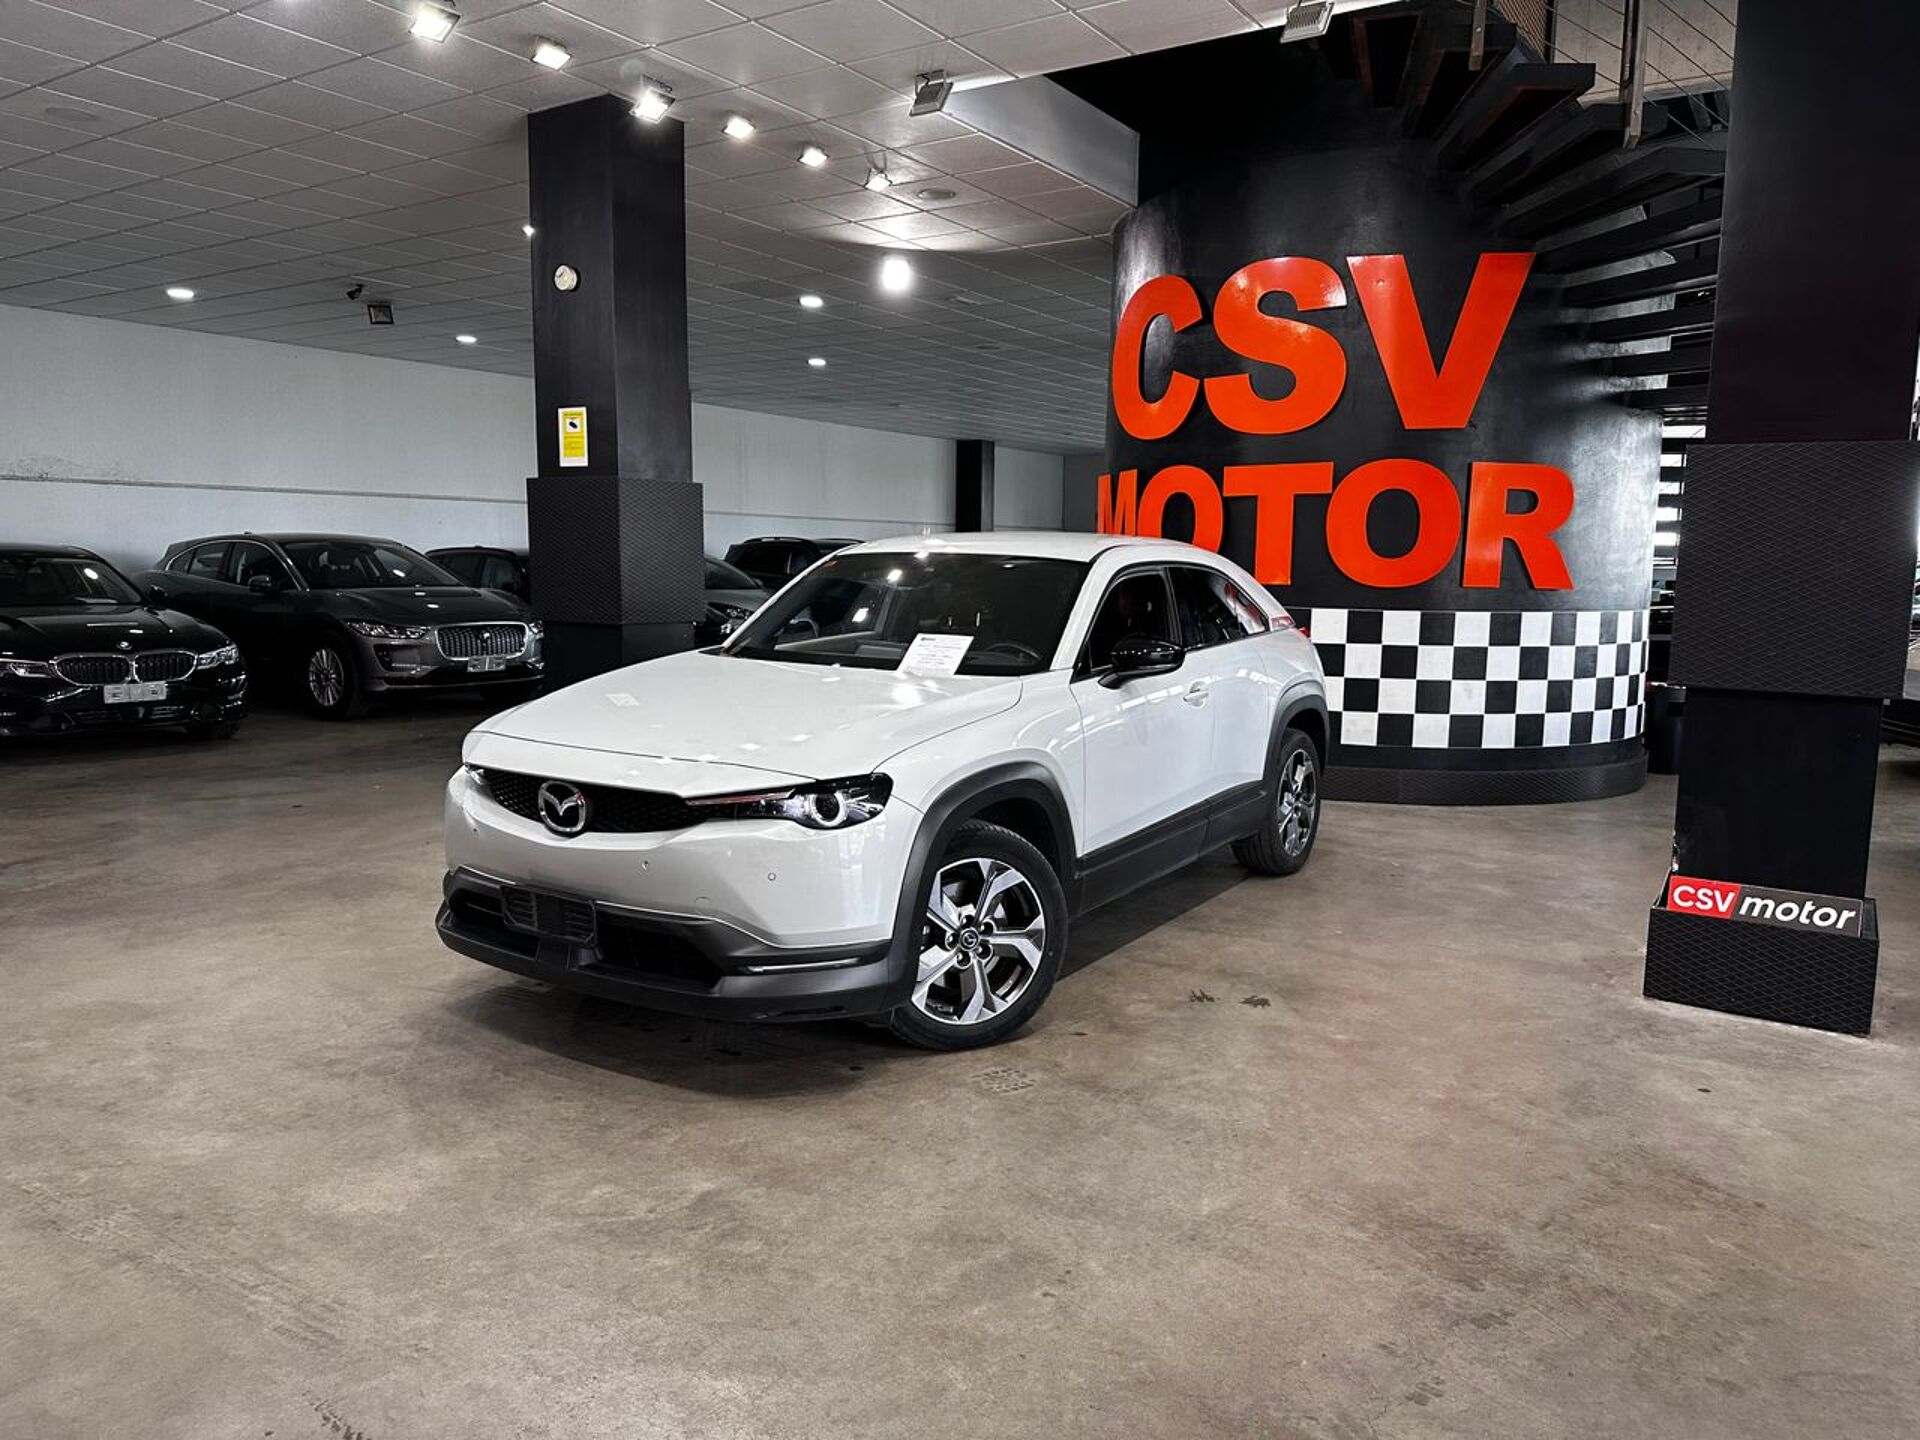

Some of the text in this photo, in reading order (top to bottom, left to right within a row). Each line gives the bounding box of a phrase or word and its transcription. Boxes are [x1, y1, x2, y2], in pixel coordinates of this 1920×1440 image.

[1112, 252, 1536, 440] CSV
[1097, 458, 1575, 591] MOTOR
[1672, 885, 1857, 930] CSV motor
